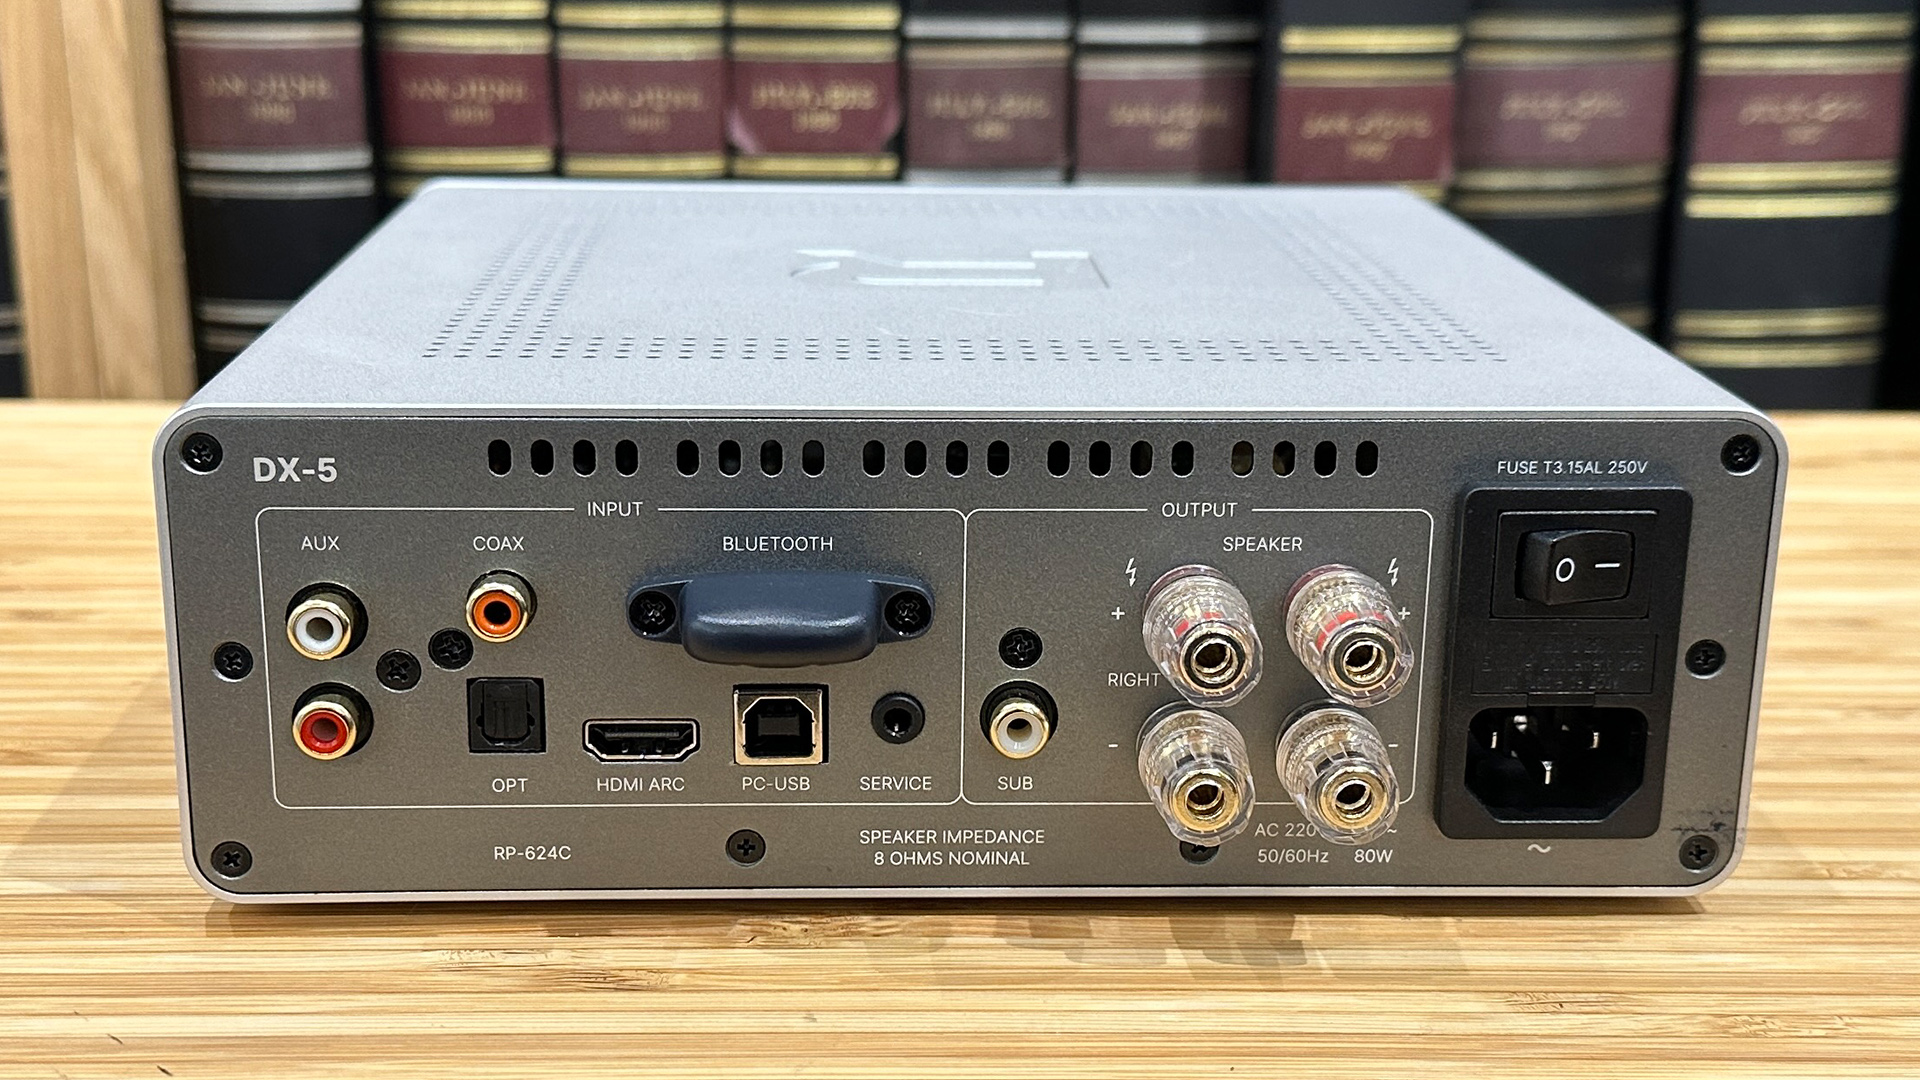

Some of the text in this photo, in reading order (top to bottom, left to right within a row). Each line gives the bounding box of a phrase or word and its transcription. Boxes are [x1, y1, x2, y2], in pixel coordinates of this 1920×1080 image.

[254, 457, 337, 482] DX-5
[1498, 461, 1648, 474] FUSE T3.15AL 250V
[588, 502, 643, 516] INPUT
[1162, 503, 1237, 517] OUTPUT
[302, 536, 340, 550] AUX
[473, 536, 524, 550] COAX
[724, 537, 832, 551] BLUETOOTH
[1223, 537, 1303, 551] SPEAKER
[1108, 673, 1161, 687] RIGHT
[492, 778, 528, 792] OPT
[597, 778, 684, 791] HDMI ARC
[743, 777, 810, 790] PC-USB
[860, 776, 931, 790] SERVICE
[998, 777, 1033, 790] SUB
[1255, 823, 1278, 836] AC
[860, 830, 1044, 844] SPEAKER IMPEDANCE
[495, 846, 571, 860] RP-624C
[875, 851, 1029, 865] 8 OHMS NOMINAL
[1258, 849, 1393, 864] 50/60Hz 80W
